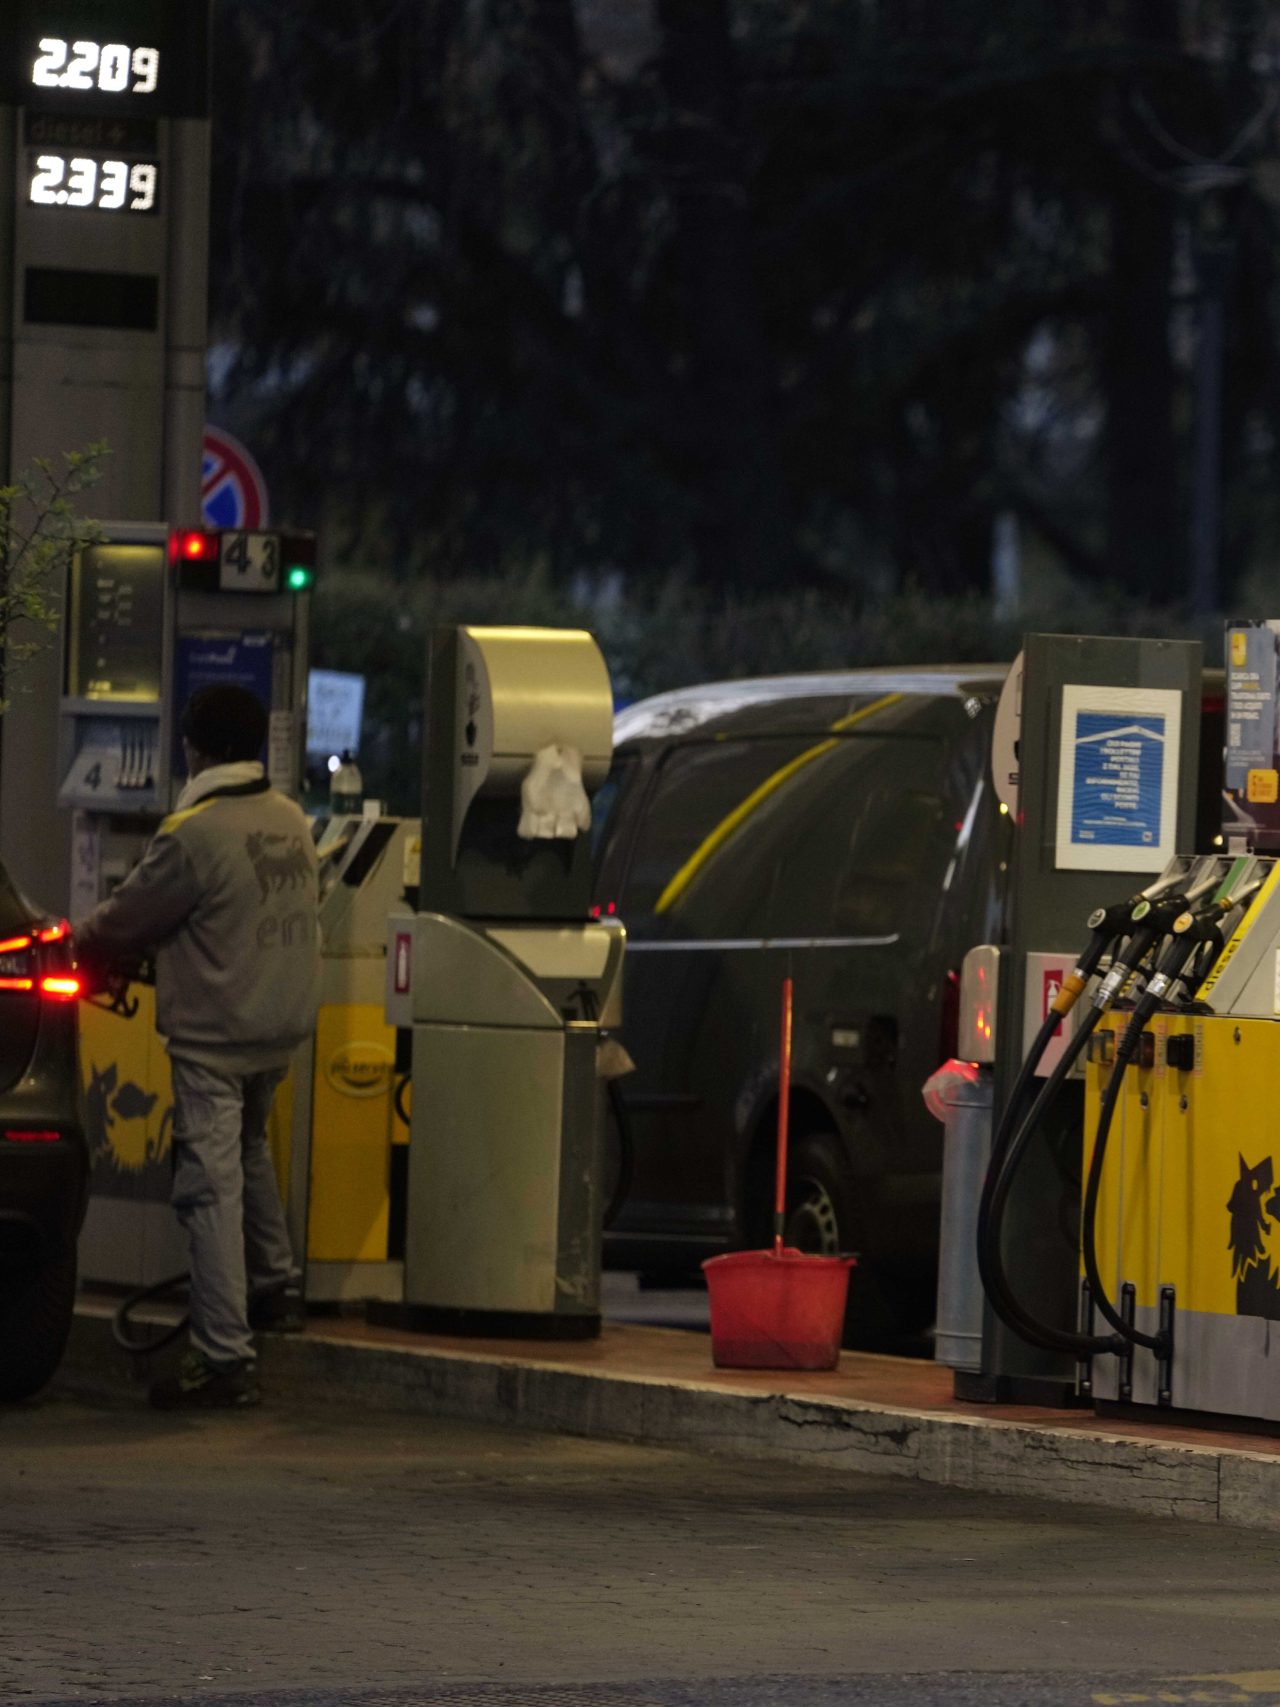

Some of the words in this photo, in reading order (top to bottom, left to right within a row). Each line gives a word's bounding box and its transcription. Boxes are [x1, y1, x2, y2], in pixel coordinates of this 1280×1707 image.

[32, 38, 160, 93] 2.209
[30, 155, 158, 210] 2.339
[226, 531, 251, 574] 4
[84, 762, 101, 790] 4
